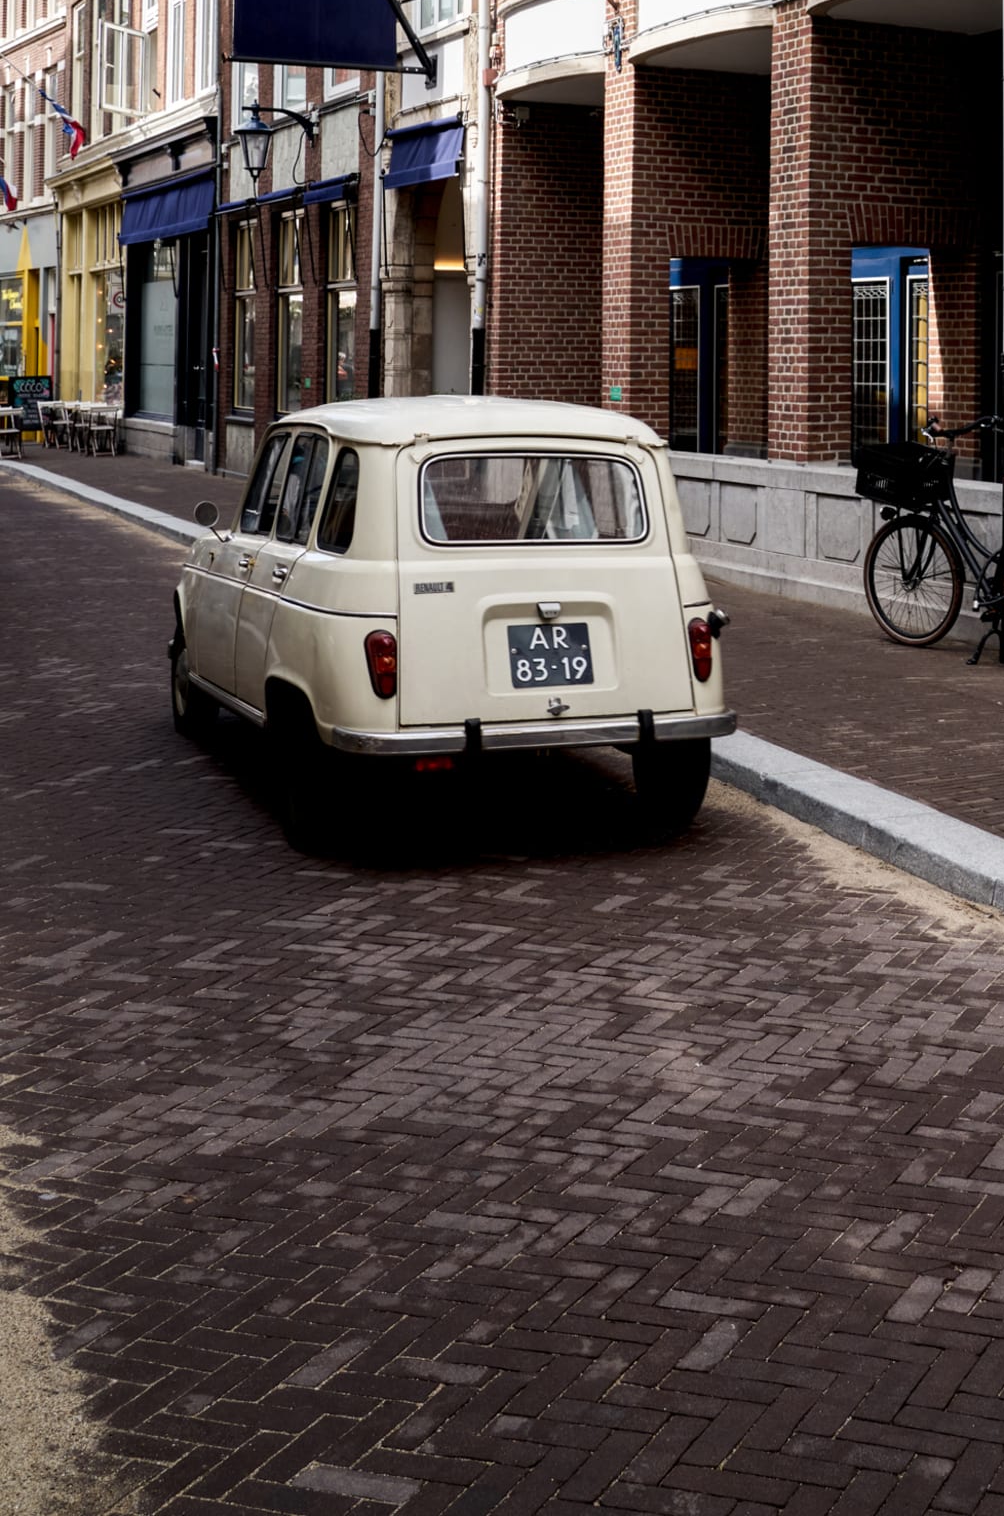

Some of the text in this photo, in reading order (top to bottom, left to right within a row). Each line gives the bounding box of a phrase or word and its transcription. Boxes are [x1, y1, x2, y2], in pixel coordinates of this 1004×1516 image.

[415, 583, 445, 594] RENAULT
[529, 626, 569, 650] AR
[516, 656, 588, 682] 83-19
